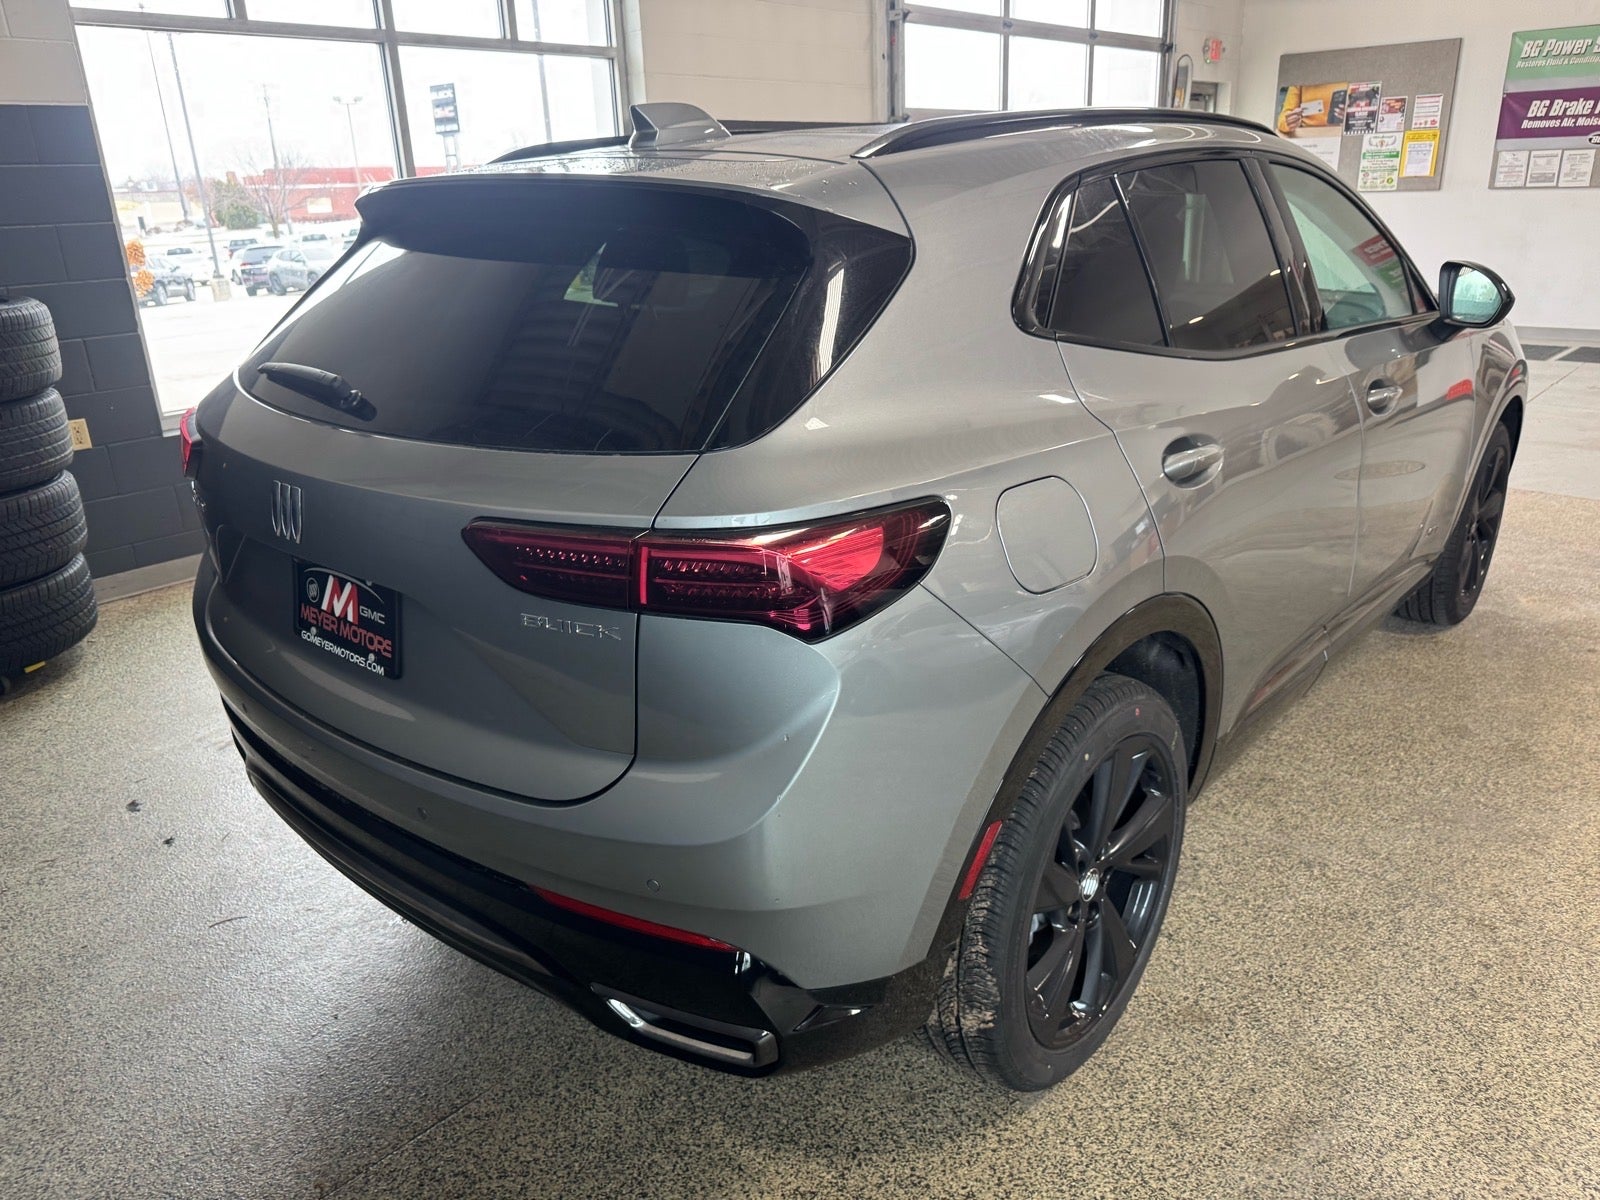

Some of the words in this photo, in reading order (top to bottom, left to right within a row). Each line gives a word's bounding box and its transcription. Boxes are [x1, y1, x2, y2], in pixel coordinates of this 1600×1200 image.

[1521, 40, 1544, 58] BG
[1542, 38, 1593, 57] Power
[1516, 59, 1545, 68] Restores
[1546, 57, 1564, 66] Fluid
[1527, 100, 1550, 117] BG
[1549, 97, 1595, 116] Brake
[1521, 117, 1561, 129] Removes
[1561, 117, 1575, 127] Air,
[321, 574, 359, 625] M
[359, 605, 385, 625] GMC
[300, 602, 338, 635] MEYER
[339, 620, 392, 659] MOTORS
[520, 612, 622, 641] BUICK
[300, 629, 385, 677] GOMEYERMOTORS.COM
